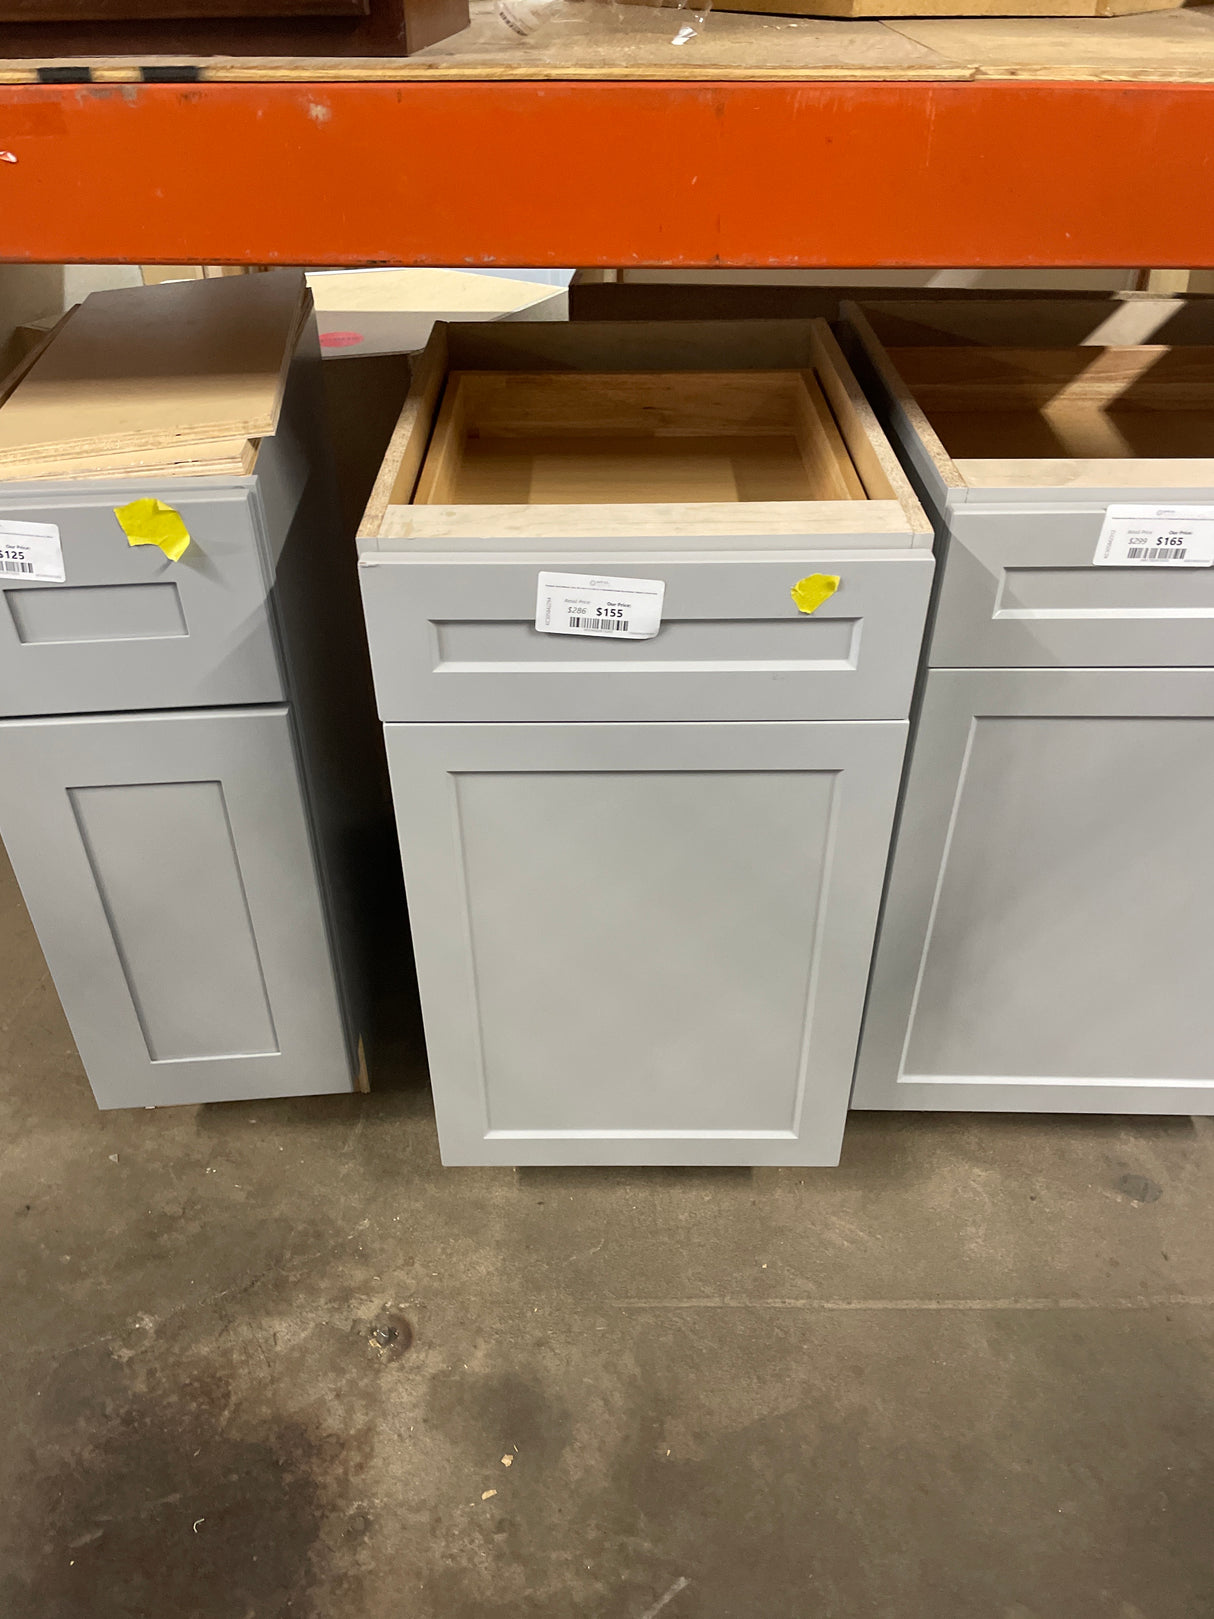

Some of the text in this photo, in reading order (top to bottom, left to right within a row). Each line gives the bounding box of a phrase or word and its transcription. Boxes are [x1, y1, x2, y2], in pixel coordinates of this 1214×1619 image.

[1128, 537, 1148, 545] $299
[1156, 536, 1184, 546] $165
[567, 606, 587, 615] $286
[596, 607, 623, 618] $155
